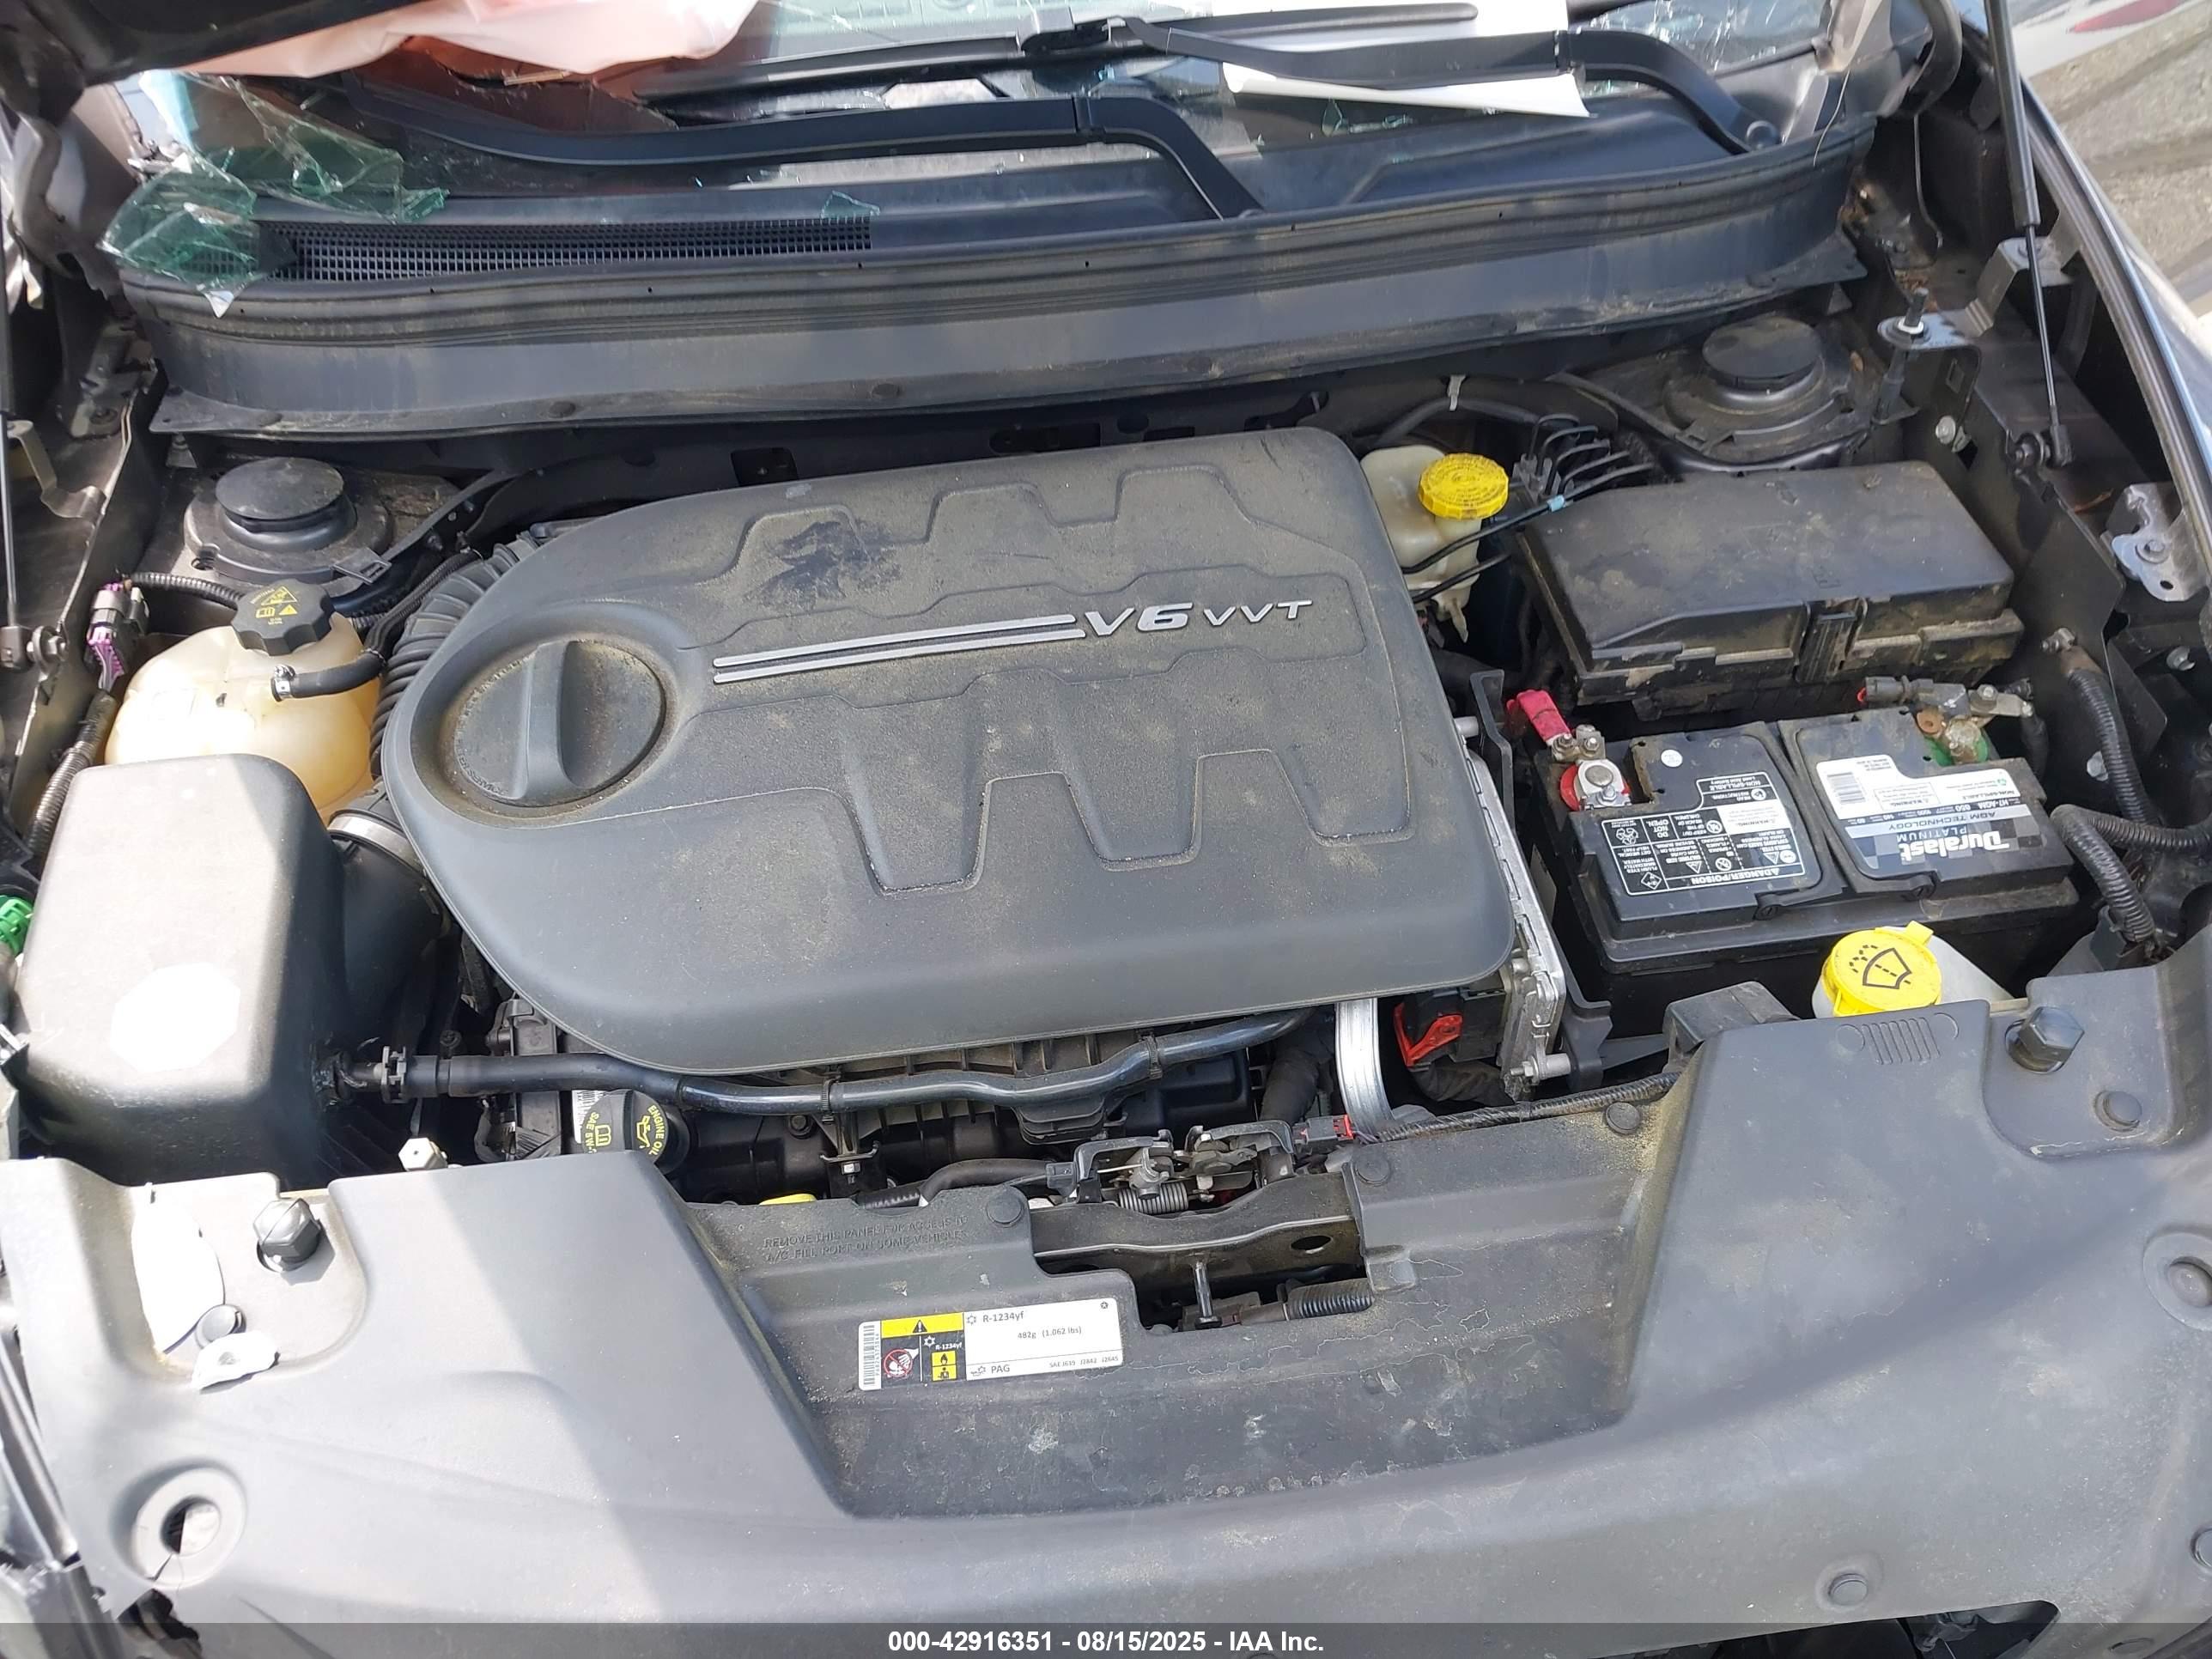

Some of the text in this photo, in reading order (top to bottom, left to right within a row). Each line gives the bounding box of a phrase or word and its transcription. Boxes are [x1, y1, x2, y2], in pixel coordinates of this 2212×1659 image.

[1085, 600, 1313, 637] V6 VVT
[1652, 825, 1669, 834] NOT
[1888, 815, 1966, 831] TECHNOLOGY
[1896, 824, 1967, 843] PLATINUM
[1898, 830, 2010, 863] Duralast
[586, 1111, 599, 1131] SAE
[647, 1104, 666, 1156] ENGINE OIL
[982, 1310, 1025, 1324] R-1234yf
[1017, 1325, 1083, 1340] 482g (1.062 lbs)
[934, 1340, 963, 1351] R-1234yf
[990, 1364, 1012, 1375] PAG
